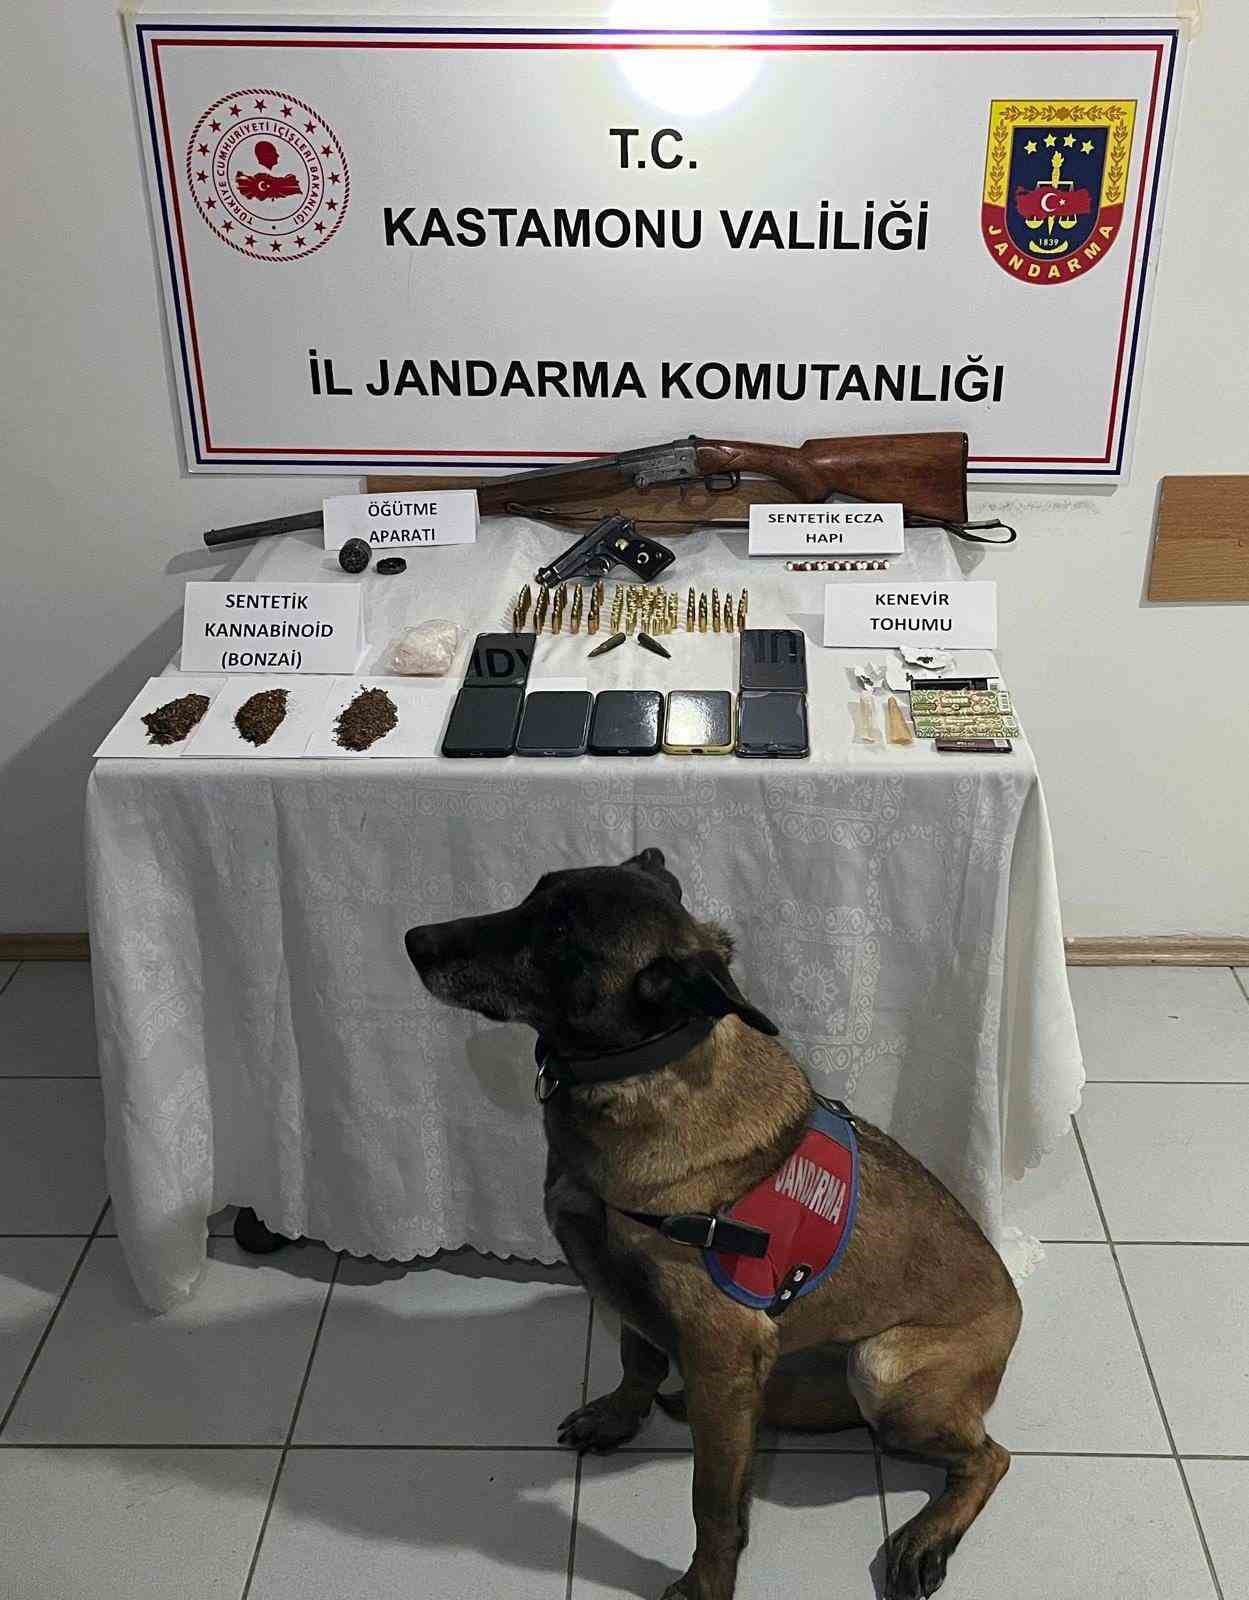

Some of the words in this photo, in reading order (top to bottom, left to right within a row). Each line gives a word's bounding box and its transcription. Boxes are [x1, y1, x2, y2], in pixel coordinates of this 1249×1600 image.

[217, 121, 269, 177] CUMHURİYETİ
[273, 123, 316, 162] İÇİŞLERİ
[609, 128, 698, 170] T.C.
[218, 181, 254, 225] TÜRKİYE
[293, 166, 320, 225] BAKANLIĞI
[383, 207, 703, 250] KASTAMONU
[719, 198, 930, 251] VALİLİĞİ
[988, 224, 1114, 278] JANDARMA
[1039, 238, 1060, 247] 1839
[308, 347, 354, 397] İL
[365, 359, 648, 400] JANDARMA
[660, 353, 1005, 403] KOMUTANLIĞI
[367, 499, 439, 518] ÖĞÜTME
[767, 510, 841, 525] SENTETİK
[844, 512, 885, 524] ECZA
[369, 528, 436, 544] APARATI
[805, 532, 844, 545] HAPI
[224, 592, 309, 611] SENTETİK
[875, 590, 950, 607] KENEVİR
[204, 619, 335, 639] KANNABİNOİD
[869, 616, 953, 633] TOHUMU
[220, 648, 303, 670] (BONZAİ)
